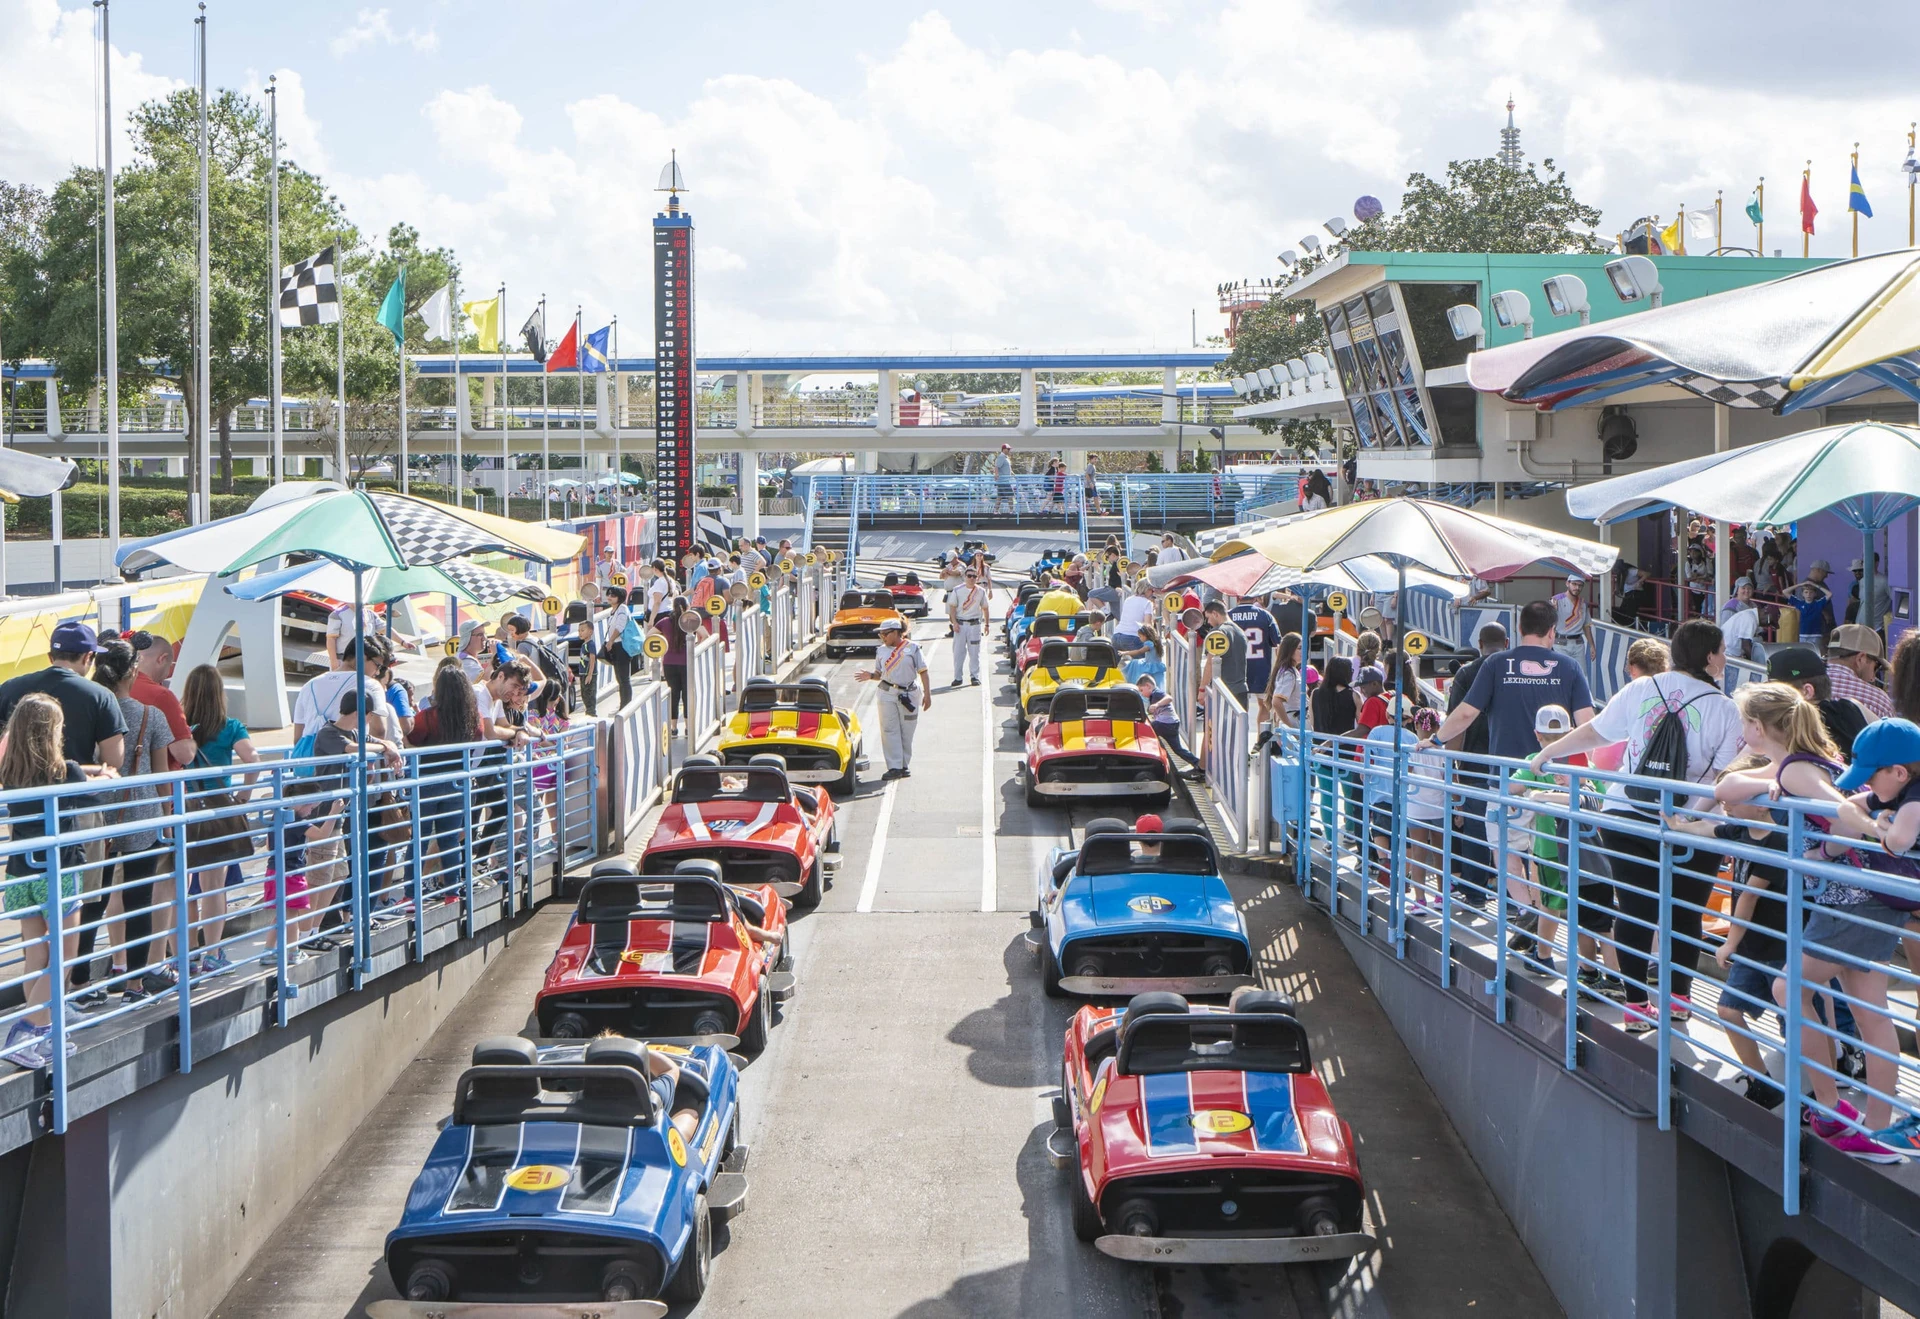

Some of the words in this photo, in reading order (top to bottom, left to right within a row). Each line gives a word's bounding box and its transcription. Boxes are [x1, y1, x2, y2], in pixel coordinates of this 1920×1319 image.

[673, 229, 686, 237] 126
[678, 390, 688, 398] 54
[1121, 561, 1128, 569] 9
[614, 577, 626, 585] 10
[752, 577, 762, 585] 4
[547, 601, 558, 611] 11
[711, 601, 721, 611] 5
[1168, 597, 1179, 607] 11
[1333, 596, 1343, 607] 3
[1232, 612, 1258, 621] BRADY
[649, 640, 662, 653] 6
[1208, 638, 1226, 650] 12
[1408, 637, 1422, 650] 4
[1506, 658, 1515, 675] I
[1503, 678, 1549, 686] LEXINGTON,
[711, 819, 741, 831] 27
[1209, 1115, 1236, 1128] 12
[523, 1171, 553, 1185] 31
